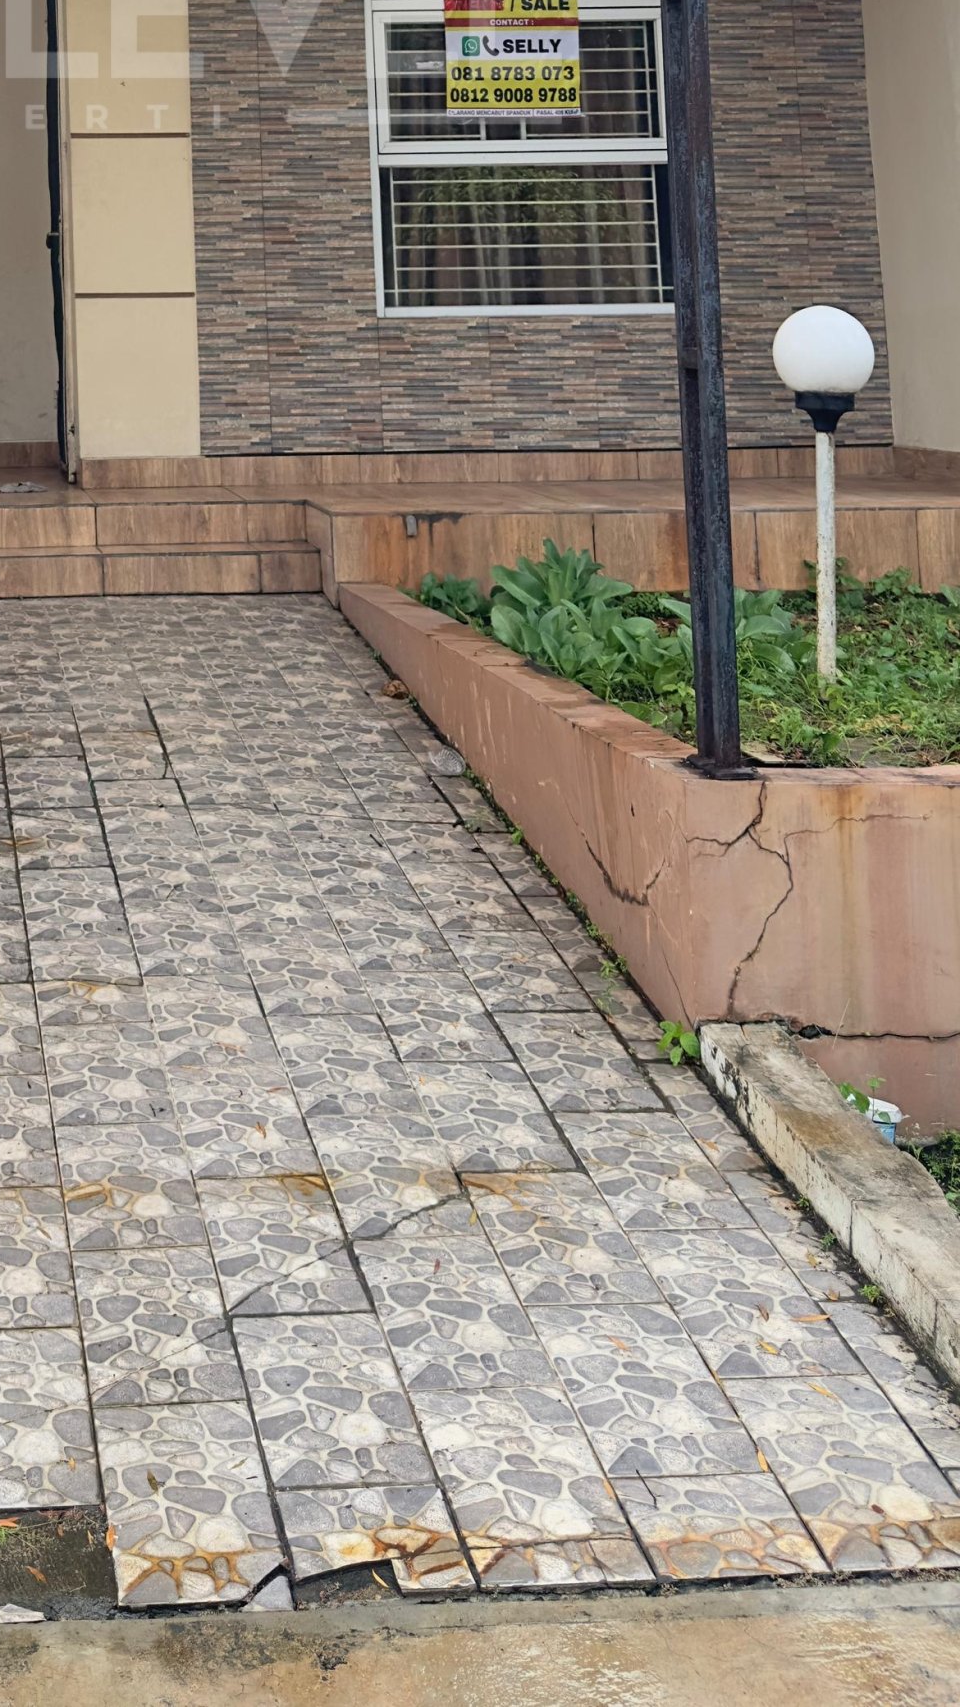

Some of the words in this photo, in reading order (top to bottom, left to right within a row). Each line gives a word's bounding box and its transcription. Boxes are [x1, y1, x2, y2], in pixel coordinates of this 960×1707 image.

[489, 18, 529, 26] CONTACT
[502, 39, 561, 53] SELLY
[451, 66, 485, 81] 081
[490, 66, 535, 81] 8783
[541, 65, 575, 81] 073
[450, 87, 489, 103] 0812
[493, 87, 533, 103] 9008
[538, 86, 577, 103] 9788
